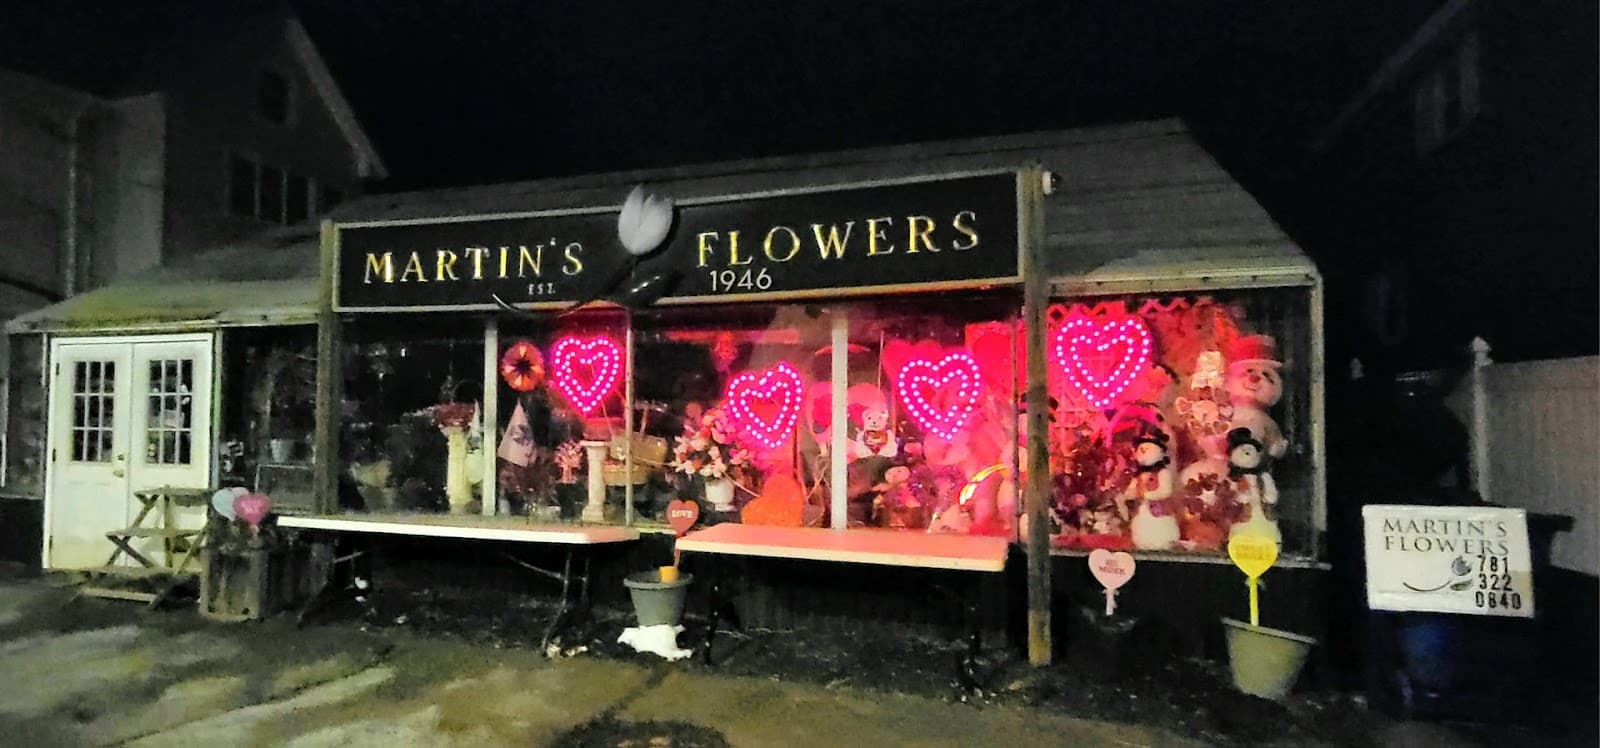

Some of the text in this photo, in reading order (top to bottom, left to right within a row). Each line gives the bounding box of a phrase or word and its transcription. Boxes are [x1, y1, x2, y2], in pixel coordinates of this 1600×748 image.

[364, 210, 979, 285] MARTIN'S FLOWERS
[528, 267, 773, 296] EST. 1946
[672, 509, 693, 518] LOVE
[1383, 518, 1508, 538] MARTIN'S
[1385, 536, 1510, 556] FLOWERS
[1476, 554, 1510, 574] 781
[1478, 573, 1513, 592] 322
[1475, 591, 1522, 610] 0840
